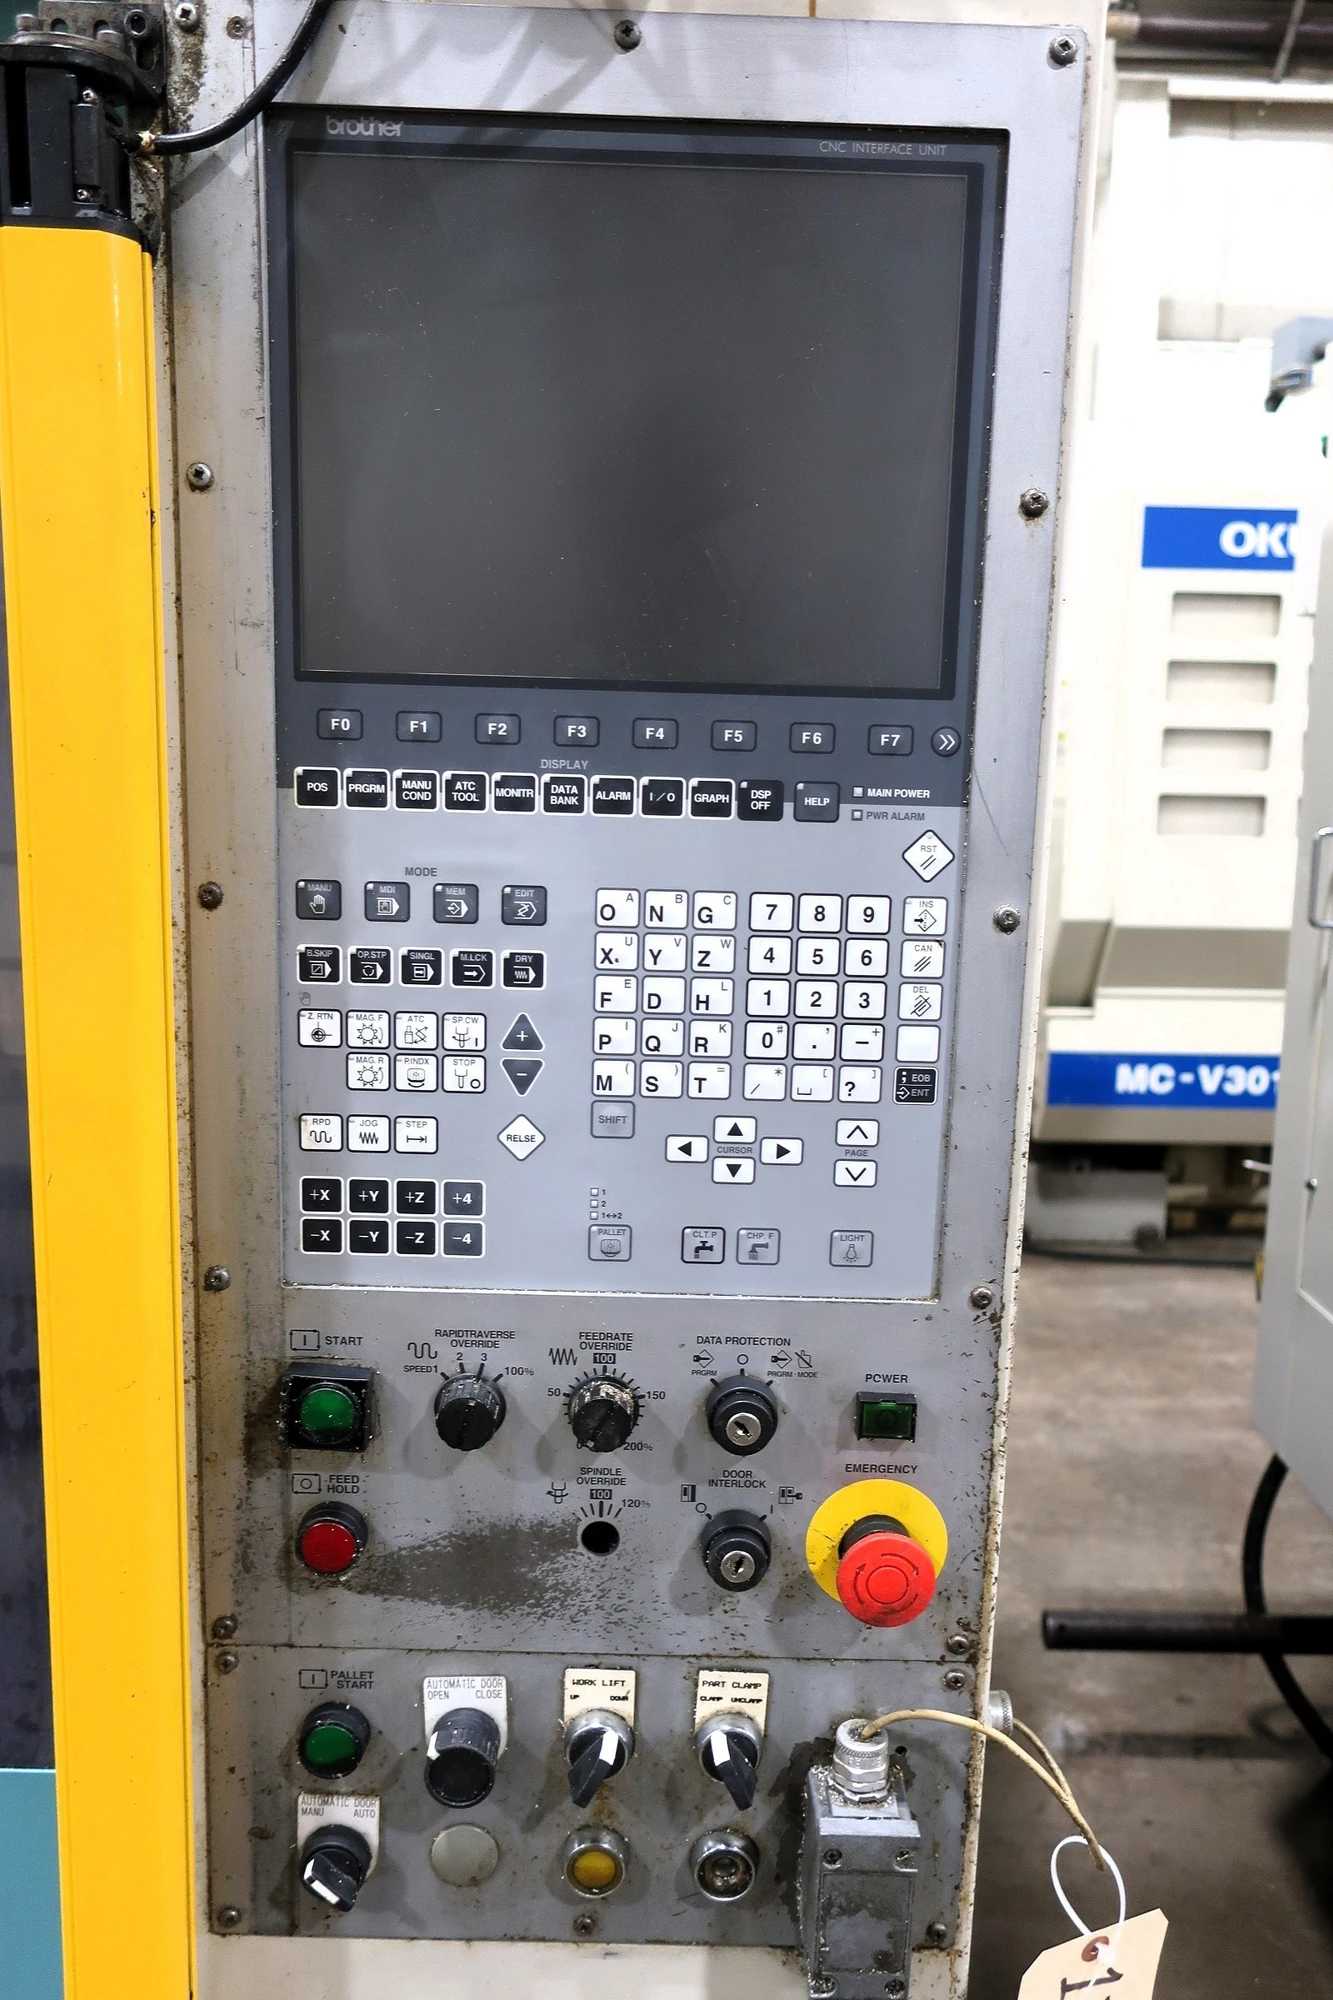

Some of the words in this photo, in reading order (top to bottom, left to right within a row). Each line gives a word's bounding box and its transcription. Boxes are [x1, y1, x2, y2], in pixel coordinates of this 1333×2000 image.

[326, 114, 403, 136] brother
[819, 141, 846, 153] CNC
[852, 142, 912, 155] INTERFACE
[919, 144, 947, 156] UNIT
[331, 719, 350, 731] F0
[410, 721, 428, 733] F1
[488, 723, 507, 735] F2
[567, 725, 586, 738] F3
[646, 728, 664, 740] F4
[724, 730, 743, 742] F5
[802, 732, 822, 744] F6
[881, 735, 900, 747] F7
[541, 759, 589, 770] DISPLAY
[307, 782, 328, 792] POS
[349, 783, 385, 795] PRGRM
[402, 780, 432, 791] MANU
[455, 781, 476, 791] ATC
[551, 785, 578, 795] DATA
[402, 790, 432, 801] COND
[452, 792, 480, 802] TOOL
[496, 787, 534, 798] MONITR
[595, 790, 632, 801] ALARM
[649, 792, 675, 802] I/O
[751, 790, 772, 800] DSP
[867, 788, 892, 797] MAIN
[894, 789, 930, 799] POWER
[550, 795, 578, 806] BANK
[694, 793, 729, 804] GRAPH
[804, 797, 830, 807] HELP
[751, 800, 771, 810] OFF
[866, 811, 889, 820] PWR
[891, 812, 925, 821] ALARM
[920, 845, 938, 853] RST
[405, 867, 438, 877] MODE
[308, 884, 332, 892] MANU
[380, 886, 396, 894] MDI
[446, 887, 466, 896] MEM
[514, 889, 534, 898] EDIT
[626, 893, 634, 903] A
[675, 894, 683, 904] B
[723, 895, 732, 905] C
[919, 901, 934, 909] INS
[600, 904, 616, 921] O
[650, 905, 664, 922] N
[697, 907, 713, 924] G
[766, 904, 778, 921] 7
[814, 905, 826, 922] 8
[863, 907, 875, 923] 9
[625, 937, 633, 946] U
[674, 938, 682, 947] V
[721, 939, 732, 949] W
[914, 944, 933, 952] CAN
[307, 949, 334, 958] B.SKIP
[357, 950, 387, 959] OP.STP
[410, 951, 435, 961] SINGL
[460, 953, 487, 962] M.LCK
[515, 954, 533, 963] DRY
[649, 949, 662, 966] Y
[697, 950, 711, 967] Z
[764, 947, 775, 964] 4
[812, 949, 824, 965] 5
[861, 950, 873, 967] 6
[624, 979, 631, 989] E
[721, 982, 728, 991] L
[913, 986, 929, 994] DEL
[600, 992, 613, 1009] F
[648, 993, 662, 1010] D
[696, 994, 710, 1011] H
[764, 990, 772, 1006] 1
[810, 991, 822, 1008] 2
[859, 992, 870, 1009] 3
[408, 1015, 425, 1023] ATC
[672, 1023, 679, 1032] J
[719, 1024, 727, 1033] K
[599, 1034, 612, 1051] P
[645, 1035, 661, 1053] Q
[695, 1036, 709, 1053] R
[762, 1032, 773, 1049] 0
[404, 1057, 430, 1065] P.INDX
[453, 1058, 476, 1066] STOP
[596, 1075, 613, 1091] M
[912, 1073, 930, 1083] EOB
[645, 1076, 659, 1093] S
[694, 1077, 707, 1093] T
[911, 1089, 930, 1097] ENT
[312, 1118, 331, 1126] RPD
[360, 1119, 378, 1128] JOG
[406, 1120, 428, 1129] STEP
[598, 1115, 628, 1125] SHIFT
[506, 1134, 536, 1144] RELSE
[717, 1146, 753, 1154] CURSOR
[845, 1149, 868, 1158] PAGE
[309, 1189, 330, 1201] +X
[359, 1191, 380, 1202] +Y
[405, 1192, 425, 1204] +Z
[452, 1193, 473, 1205] +4
[598, 1228, 627, 1236] PALLET
[840, 1234, 865, 1242] LIGHT
[435, 1329, 515, 1339] RAPIDTRAVERSE
[579, 1331, 633, 1342] FEEDRATE
[325, 1336, 363, 1346] START
[450, 1339, 500, 1349] OVERRIDE
[579, 1341, 633, 1351] OVERRIDE
[697, 1336, 722, 1345] DATA
[725, 1336, 791, 1346] PROTECTION
[457, 1352, 463, 1361] 2
[481, 1353, 488, 1361] 3
[595, 1354, 614, 1364] 100
[505, 1367, 535, 1376] 100%
[865, 1373, 909, 1384] POWER
[548, 1388, 561, 1397] 50
[647, 1391, 666, 1400] 150
[624, 1442, 653, 1451] 200%
[580, 1467, 622, 1477] SPINDLE
[845, 1463, 918, 1474] EMERGENCY
[723, 1469, 753, 1479] DOOR
[329, 1475, 360, 1484] FEED
[576, 1477, 627, 1486] OVERRIDE
[708, 1479, 767, 1489] INTERLOCK
[327, 1485, 360, 1494] HOLD
[592, 1489, 611, 1499] 100
[622, 1499, 650, 1508] 120%
[330, 1670, 374, 1680] PALLET
[336, 1680, 374, 1690] START
[427, 1679, 476, 1689] AUTOMATIC
[481, 1680, 504, 1689] DOOR
[602, 1679, 626, 1687] LIFT
[427, 1691, 450, 1700] OPEN
[475, 1690, 503, 1699] CLOSE
[301, 1796, 350, 1808] AUTOMATIC
[354, 1799, 377, 1808] DOOR
[301, 1808, 325, 1817] MANU
[353, 1809, 376, 1818] AUTO
